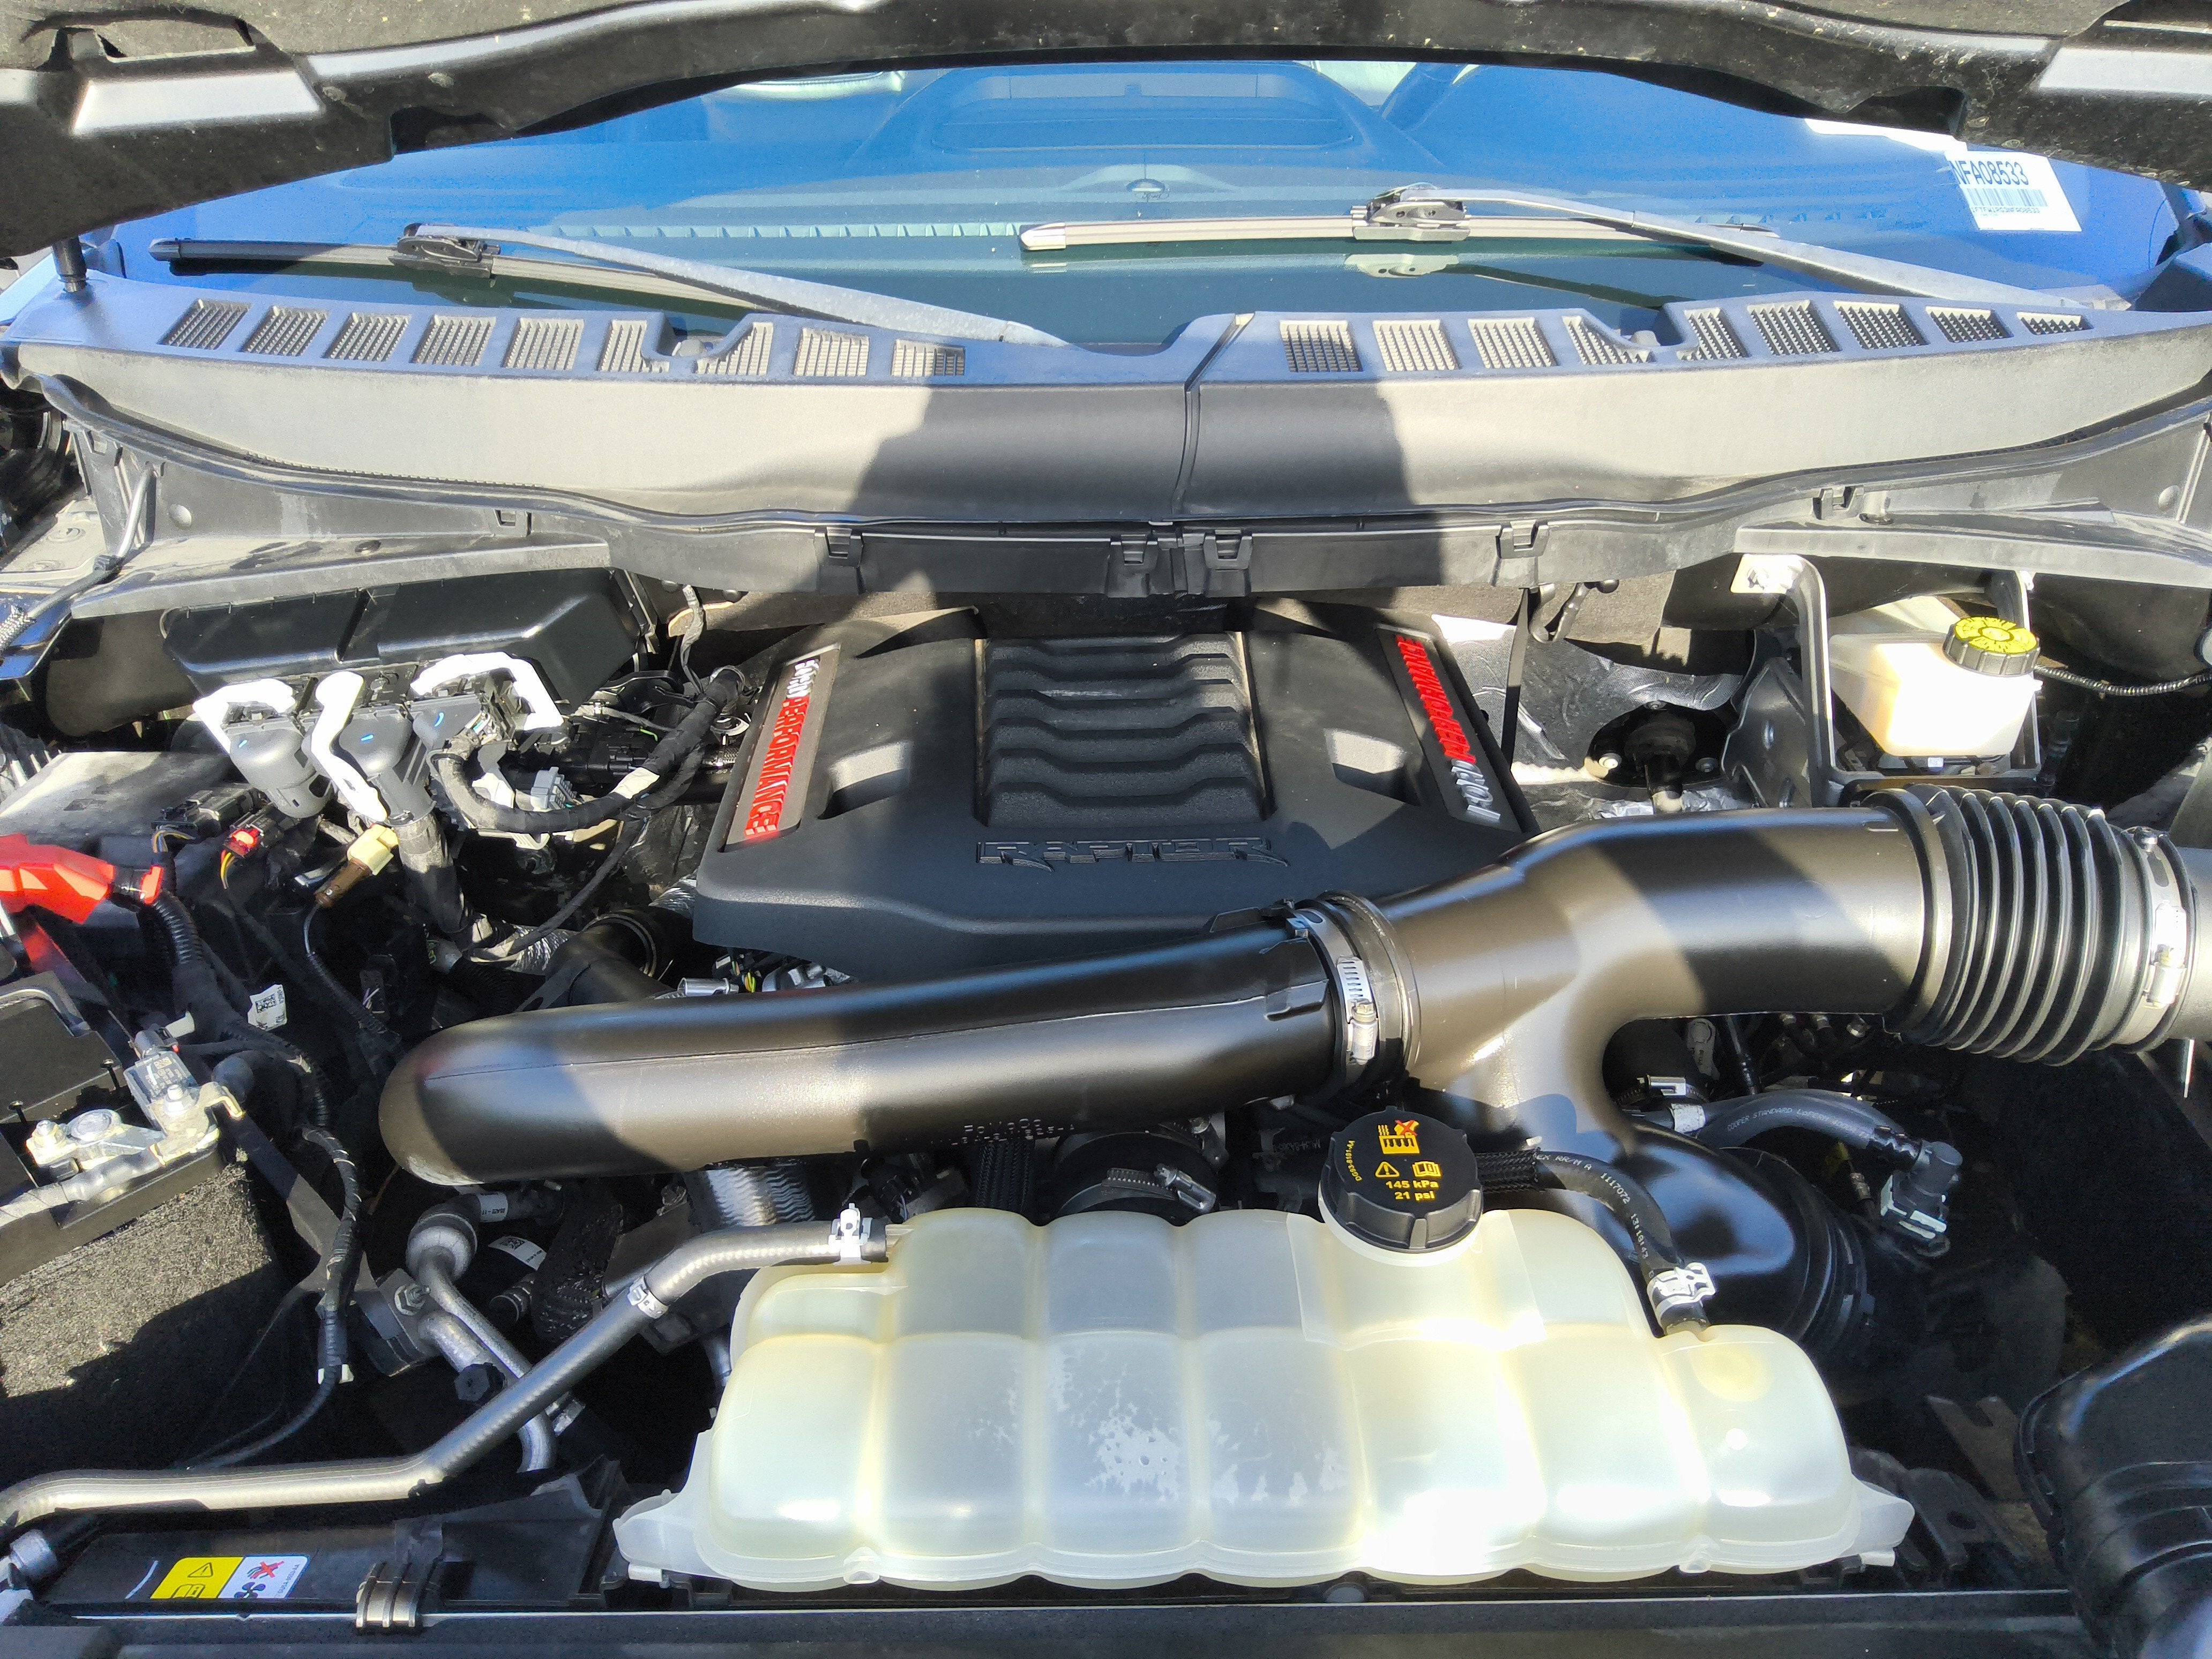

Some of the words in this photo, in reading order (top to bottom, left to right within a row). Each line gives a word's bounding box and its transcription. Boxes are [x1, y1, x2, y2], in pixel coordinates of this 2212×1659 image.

[1949, 160, 2029, 185] NFA08533
[1395, 636, 1476, 764] PERFORMANCE
[745, 697, 810, 836] PERFORMANCE
[1450, 758, 1501, 820] FORD
[975, 838, 1289, 873] RAPTOR
[1752, 1107, 1793, 1119] STANDARD
[1386, 1180, 1410, 1190] 145
[1413, 1180, 1439, 1190] kPa
[1394, 1191, 1410, 1200] 21
[1415, 1190, 1435, 1201] psi
[1600, 1172, 1631, 1205] 1117072
